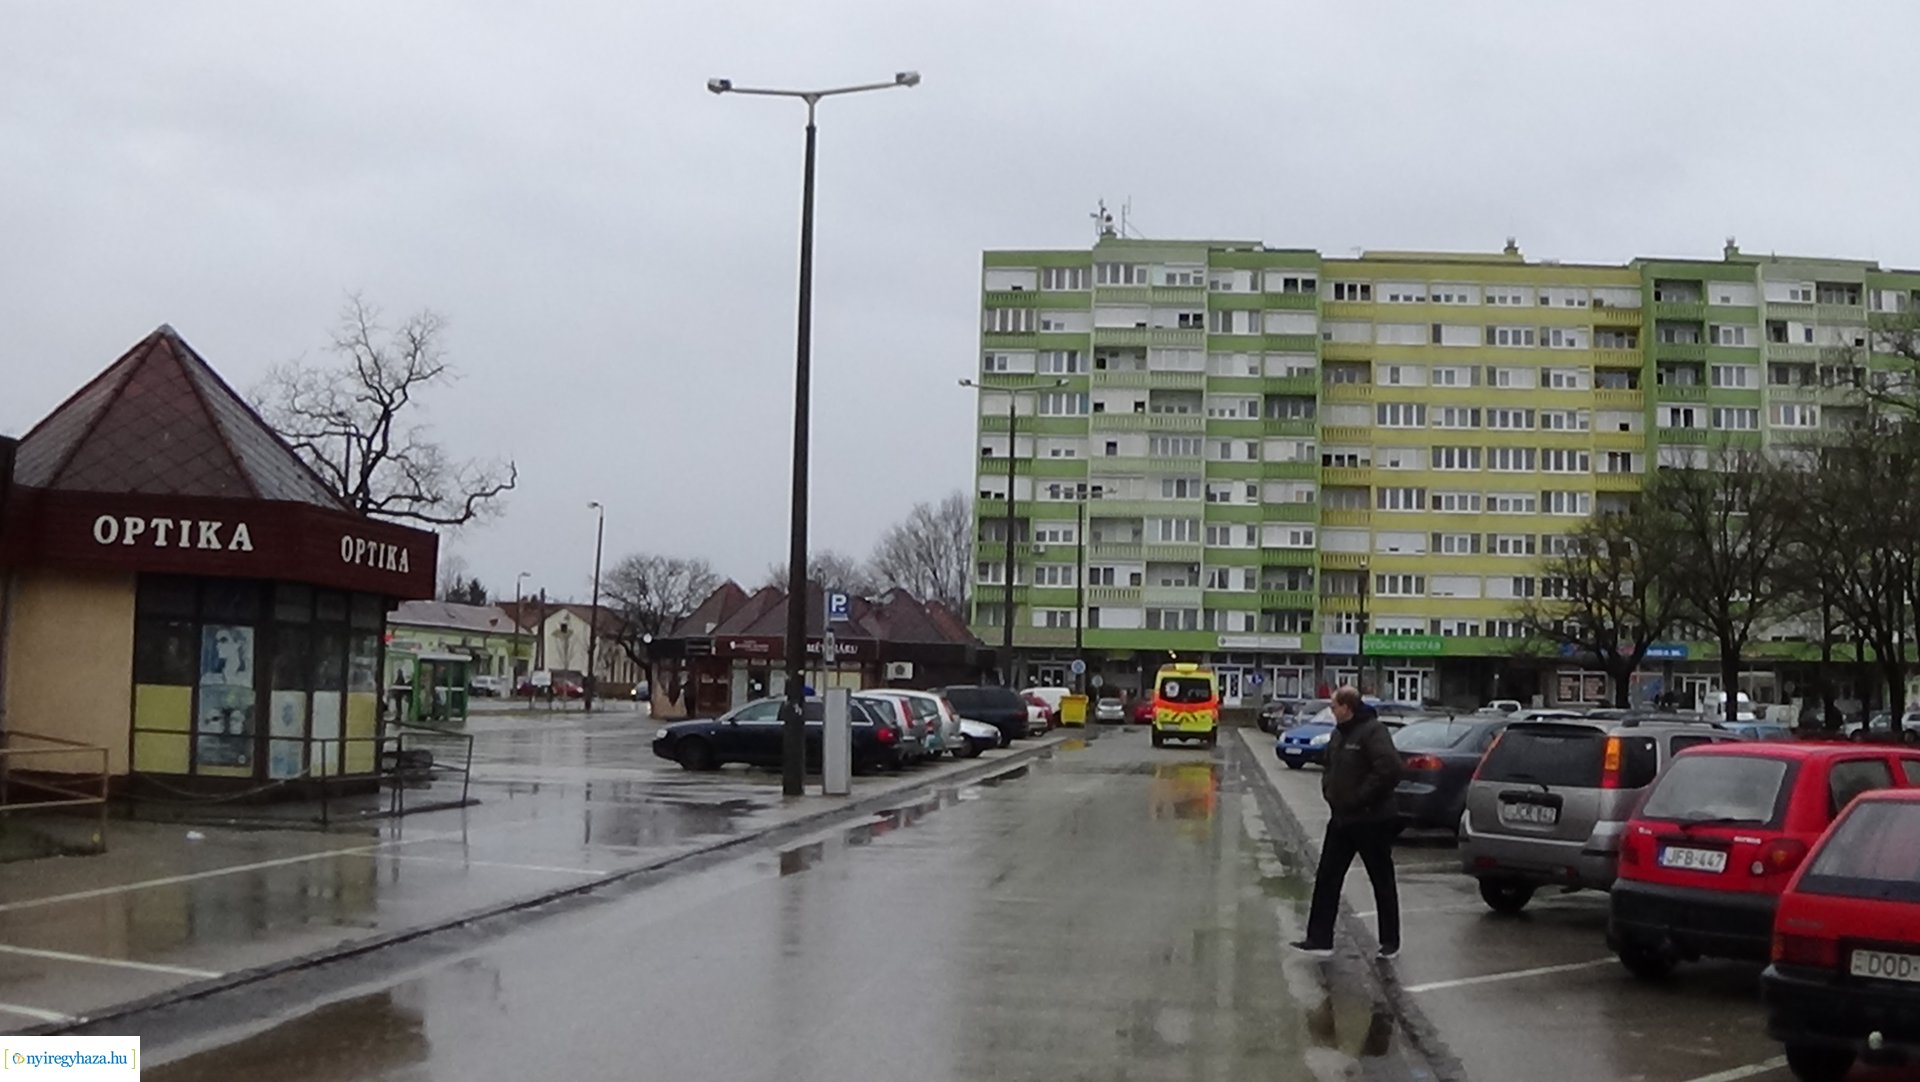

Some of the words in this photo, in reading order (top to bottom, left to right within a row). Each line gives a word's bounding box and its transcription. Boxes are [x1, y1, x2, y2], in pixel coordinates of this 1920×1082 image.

[93, 515, 254, 551] OPTIKA
[340, 534, 410, 573] OPTIKA
[831, 594, 847, 612] P
[1667, 849, 1725, 869] JFB-447
